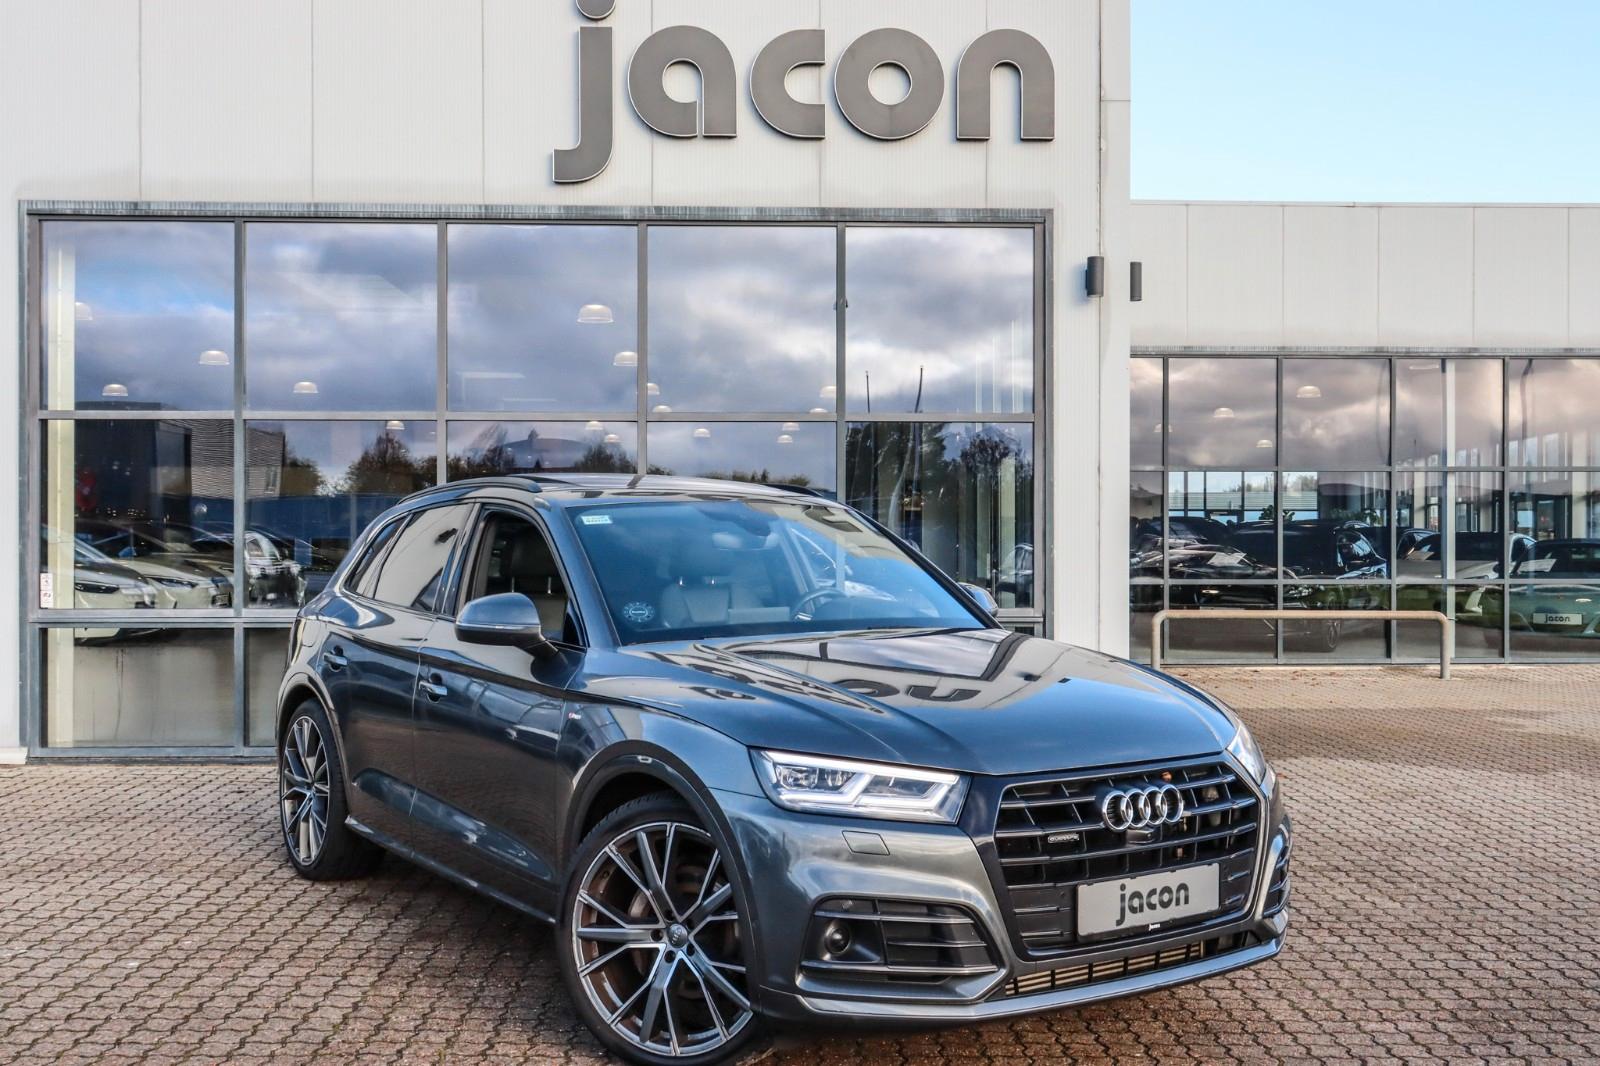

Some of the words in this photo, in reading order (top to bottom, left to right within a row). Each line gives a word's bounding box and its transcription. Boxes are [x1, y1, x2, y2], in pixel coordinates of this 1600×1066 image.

[552, 0, 1054, 184] jacon
[1544, 614, 1571, 624] jacon
[1115, 882, 1190, 927] jacon
